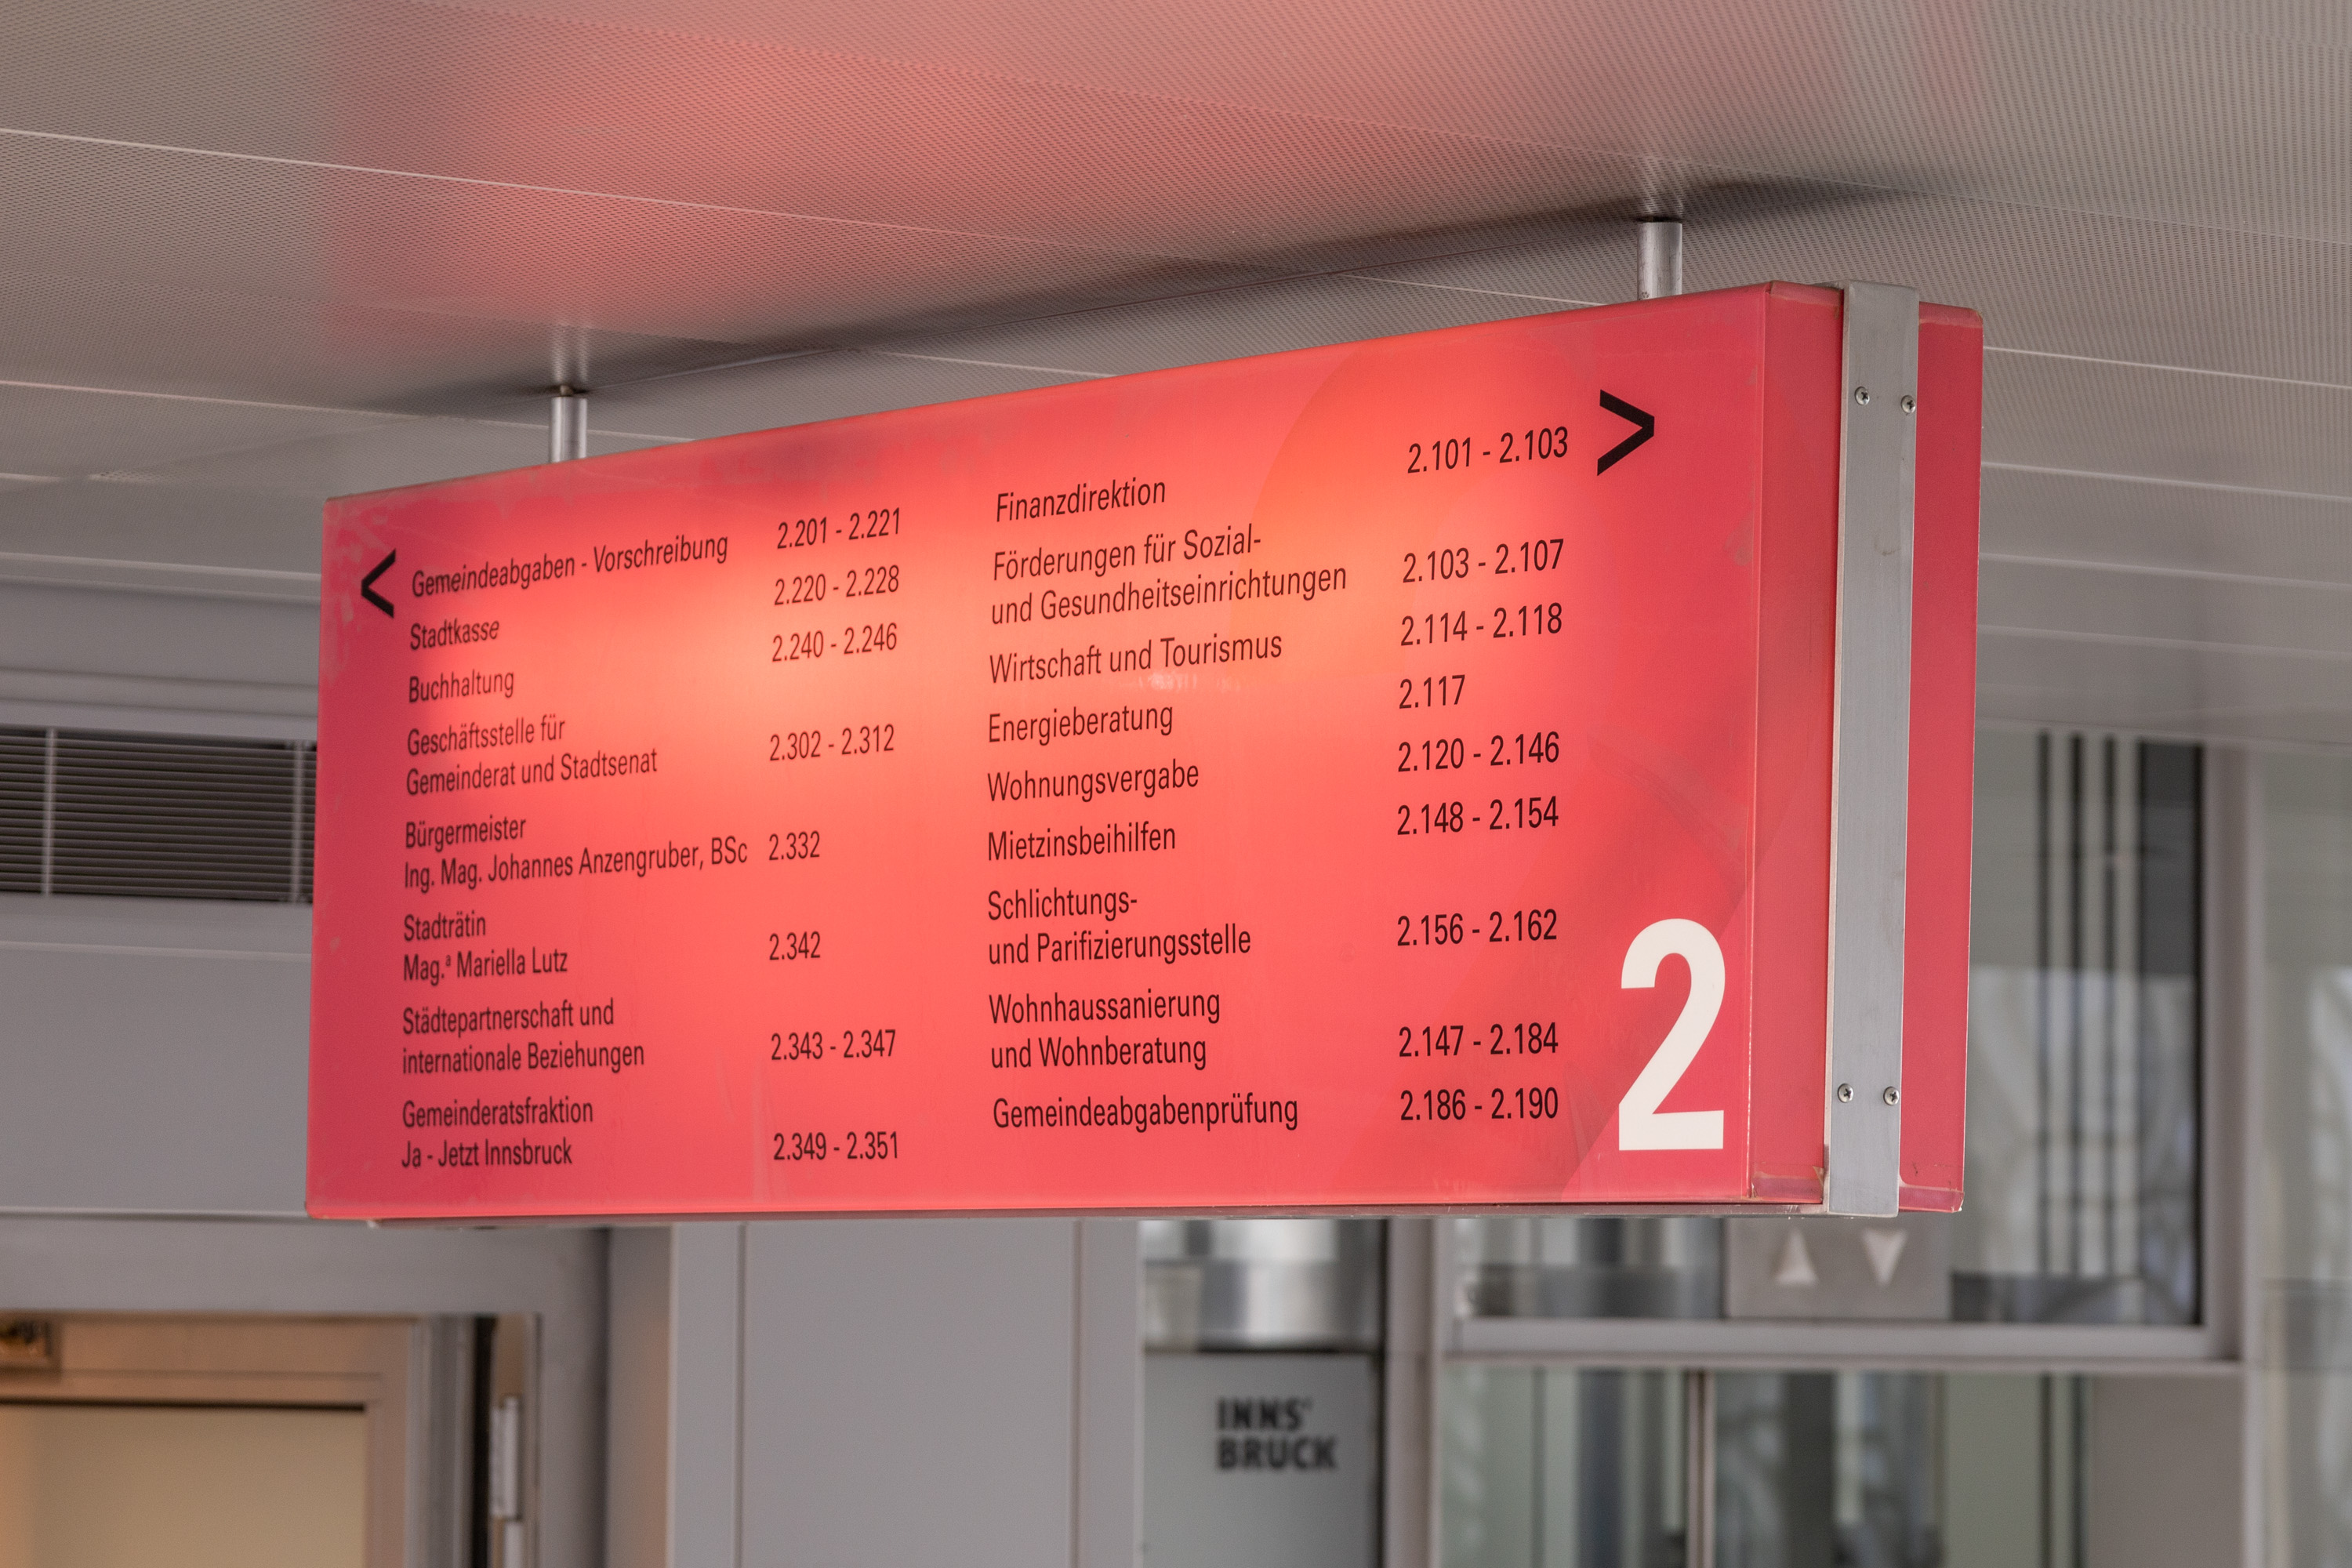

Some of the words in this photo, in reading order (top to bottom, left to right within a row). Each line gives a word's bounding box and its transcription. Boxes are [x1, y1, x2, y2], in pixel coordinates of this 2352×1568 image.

[1407, 437, 1471, 474] 2.101
[1500, 426, 1568, 463] 2.103
[996, 477, 1165, 522] Finanzdirektion
[777, 517, 826, 549] 2.201
[849, 507, 899, 540] 2.221
[412, 554, 575, 597] Gemeindeabgaben
[593, 535, 728, 572] Vorschreibung
[993, 544, 1135, 581] Förderungen
[1144, 534, 1176, 564] für
[1184, 523, 1261, 560] Sozial-
[1403, 548, 1468, 583] 2.103
[1495, 539, 1563, 574] 2.107
[775, 574, 826, 605] 2.220
[847, 565, 899, 597] 2.228
[993, 593, 1032, 624] und
[1040, 567, 1346, 620] Gesundheitseinrichtungen
[410, 619, 499, 651] Stadtkasse
[773, 631, 823, 662] 2.240
[844, 622, 896, 654] 2.246
[1401, 611, 1468, 646] 2.114
[1494, 602, 1562, 638] 2.118
[990, 645, 1102, 683] Wirtschaft
[1110, 640, 1151, 672] und
[1160, 633, 1281, 667] Tourismus
[409, 671, 514, 703] Buchhaltung
[1399, 674, 1465, 709] 2.117
[408, 719, 534, 757] Geschäftsstelle
[541, 715, 564, 740] für
[770, 731, 820, 760] 2.302
[842, 724, 894, 755] 2.312
[989, 706, 1172, 746] Energieberatung
[1398, 738, 1464, 772] 2.120
[1490, 731, 1559, 766] 2.146
[407, 763, 515, 796] Gemeinderat
[522, 756, 554, 784] und
[561, 750, 656, 780] Stadtsenat
[988, 759, 1199, 802] Wohnungsvergabe
[406, 815, 526, 853] Bürgermeister
[1397, 801, 1464, 835] 2.148
[1490, 796, 1559, 830] 2.154
[769, 831, 819, 861] 2.332
[989, 821, 1175, 861] Mietzinsbeihilfen
[405, 862, 434, 895] Ing.
[441, 858, 482, 891] Mag.
[488, 854, 573, 882] Johannes
[579, 841, 703, 877] Anzengruber,
[712, 836, 747, 865] BSc
[989, 887, 1137, 922] Schlichtungs-
[404, 910, 485, 942] Stadträtin
[769, 931, 820, 960] 2.342
[989, 934, 1029, 964] und
[1038, 923, 1250, 964] Parifizierungsstelle
[1397, 913, 1464, 946] 2.156
[1489, 909, 1557, 942] 2.162
[457, 949, 525, 978] Mariella
[532, 947, 568, 974] Lutz
[403, 999, 574, 1038] Städtepartnerschaft
[580, 997, 614, 1026] und
[989, 988, 1220, 1024] Wohnhaussanierung
[771, 1032, 823, 1061] 2.343
[844, 1029, 895, 1058] 2.347
[992, 1038, 1031, 1069] und
[1038, 1035, 1206, 1071] Wohnberatung
[1399, 1025, 1464, 1058] 2.147
[1490, 1022, 1559, 1054] 2.184
[1618, 918, 1726, 1150] 2
[403, 1044, 521, 1074] internationale
[528, 1040, 644, 1074] Beziehungen
[403, 1096, 593, 1128] Gemeinderatsfraktion
[993, 1092, 1298, 1133] Gemeindeabgabenprüfung
[1400, 1088, 1466, 1120] 2.186
[1491, 1087, 1559, 1119] 2.190
[401, 1141, 421, 1168] Ja
[438, 1140, 479, 1167] Jetzt
[485, 1137, 572, 1166] Innsbruck
[774, 1132, 826, 1160] 2.349
[847, 1131, 898, 1160] 2.351
[1217, 1437, 1338, 1470] BRUCK
